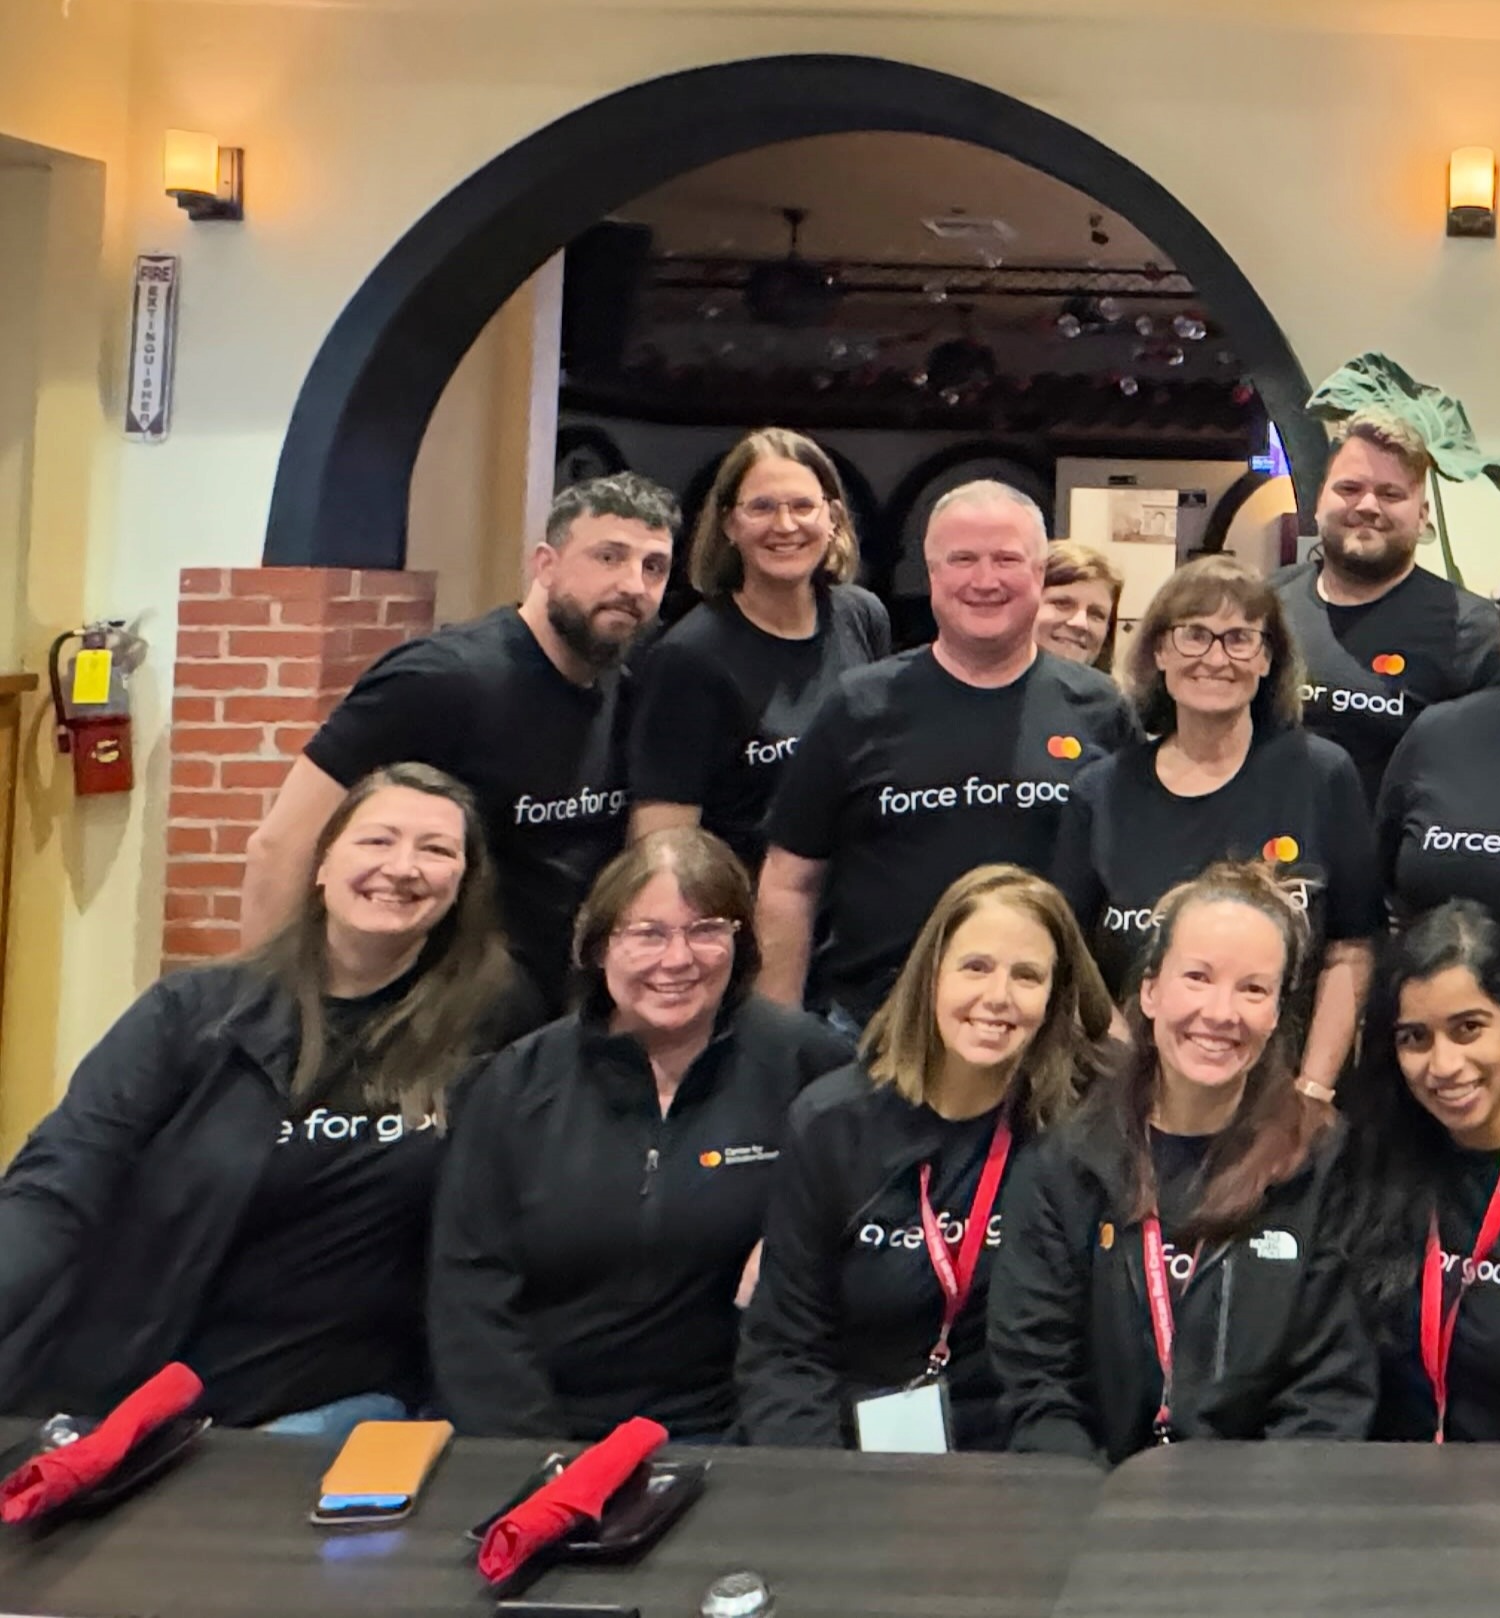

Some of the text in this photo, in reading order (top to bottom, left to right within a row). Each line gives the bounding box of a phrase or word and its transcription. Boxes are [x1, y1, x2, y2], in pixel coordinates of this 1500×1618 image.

[140, 266, 171, 282] FIRE
[139, 285, 159, 424] EXTINGUISHER
[1297, 684, 1405, 716] or good
[514, 794, 578, 825] force
[580, 786, 609, 815] for
[878, 776, 1070, 816] force for goo
[304, 1108, 368, 1140] for
